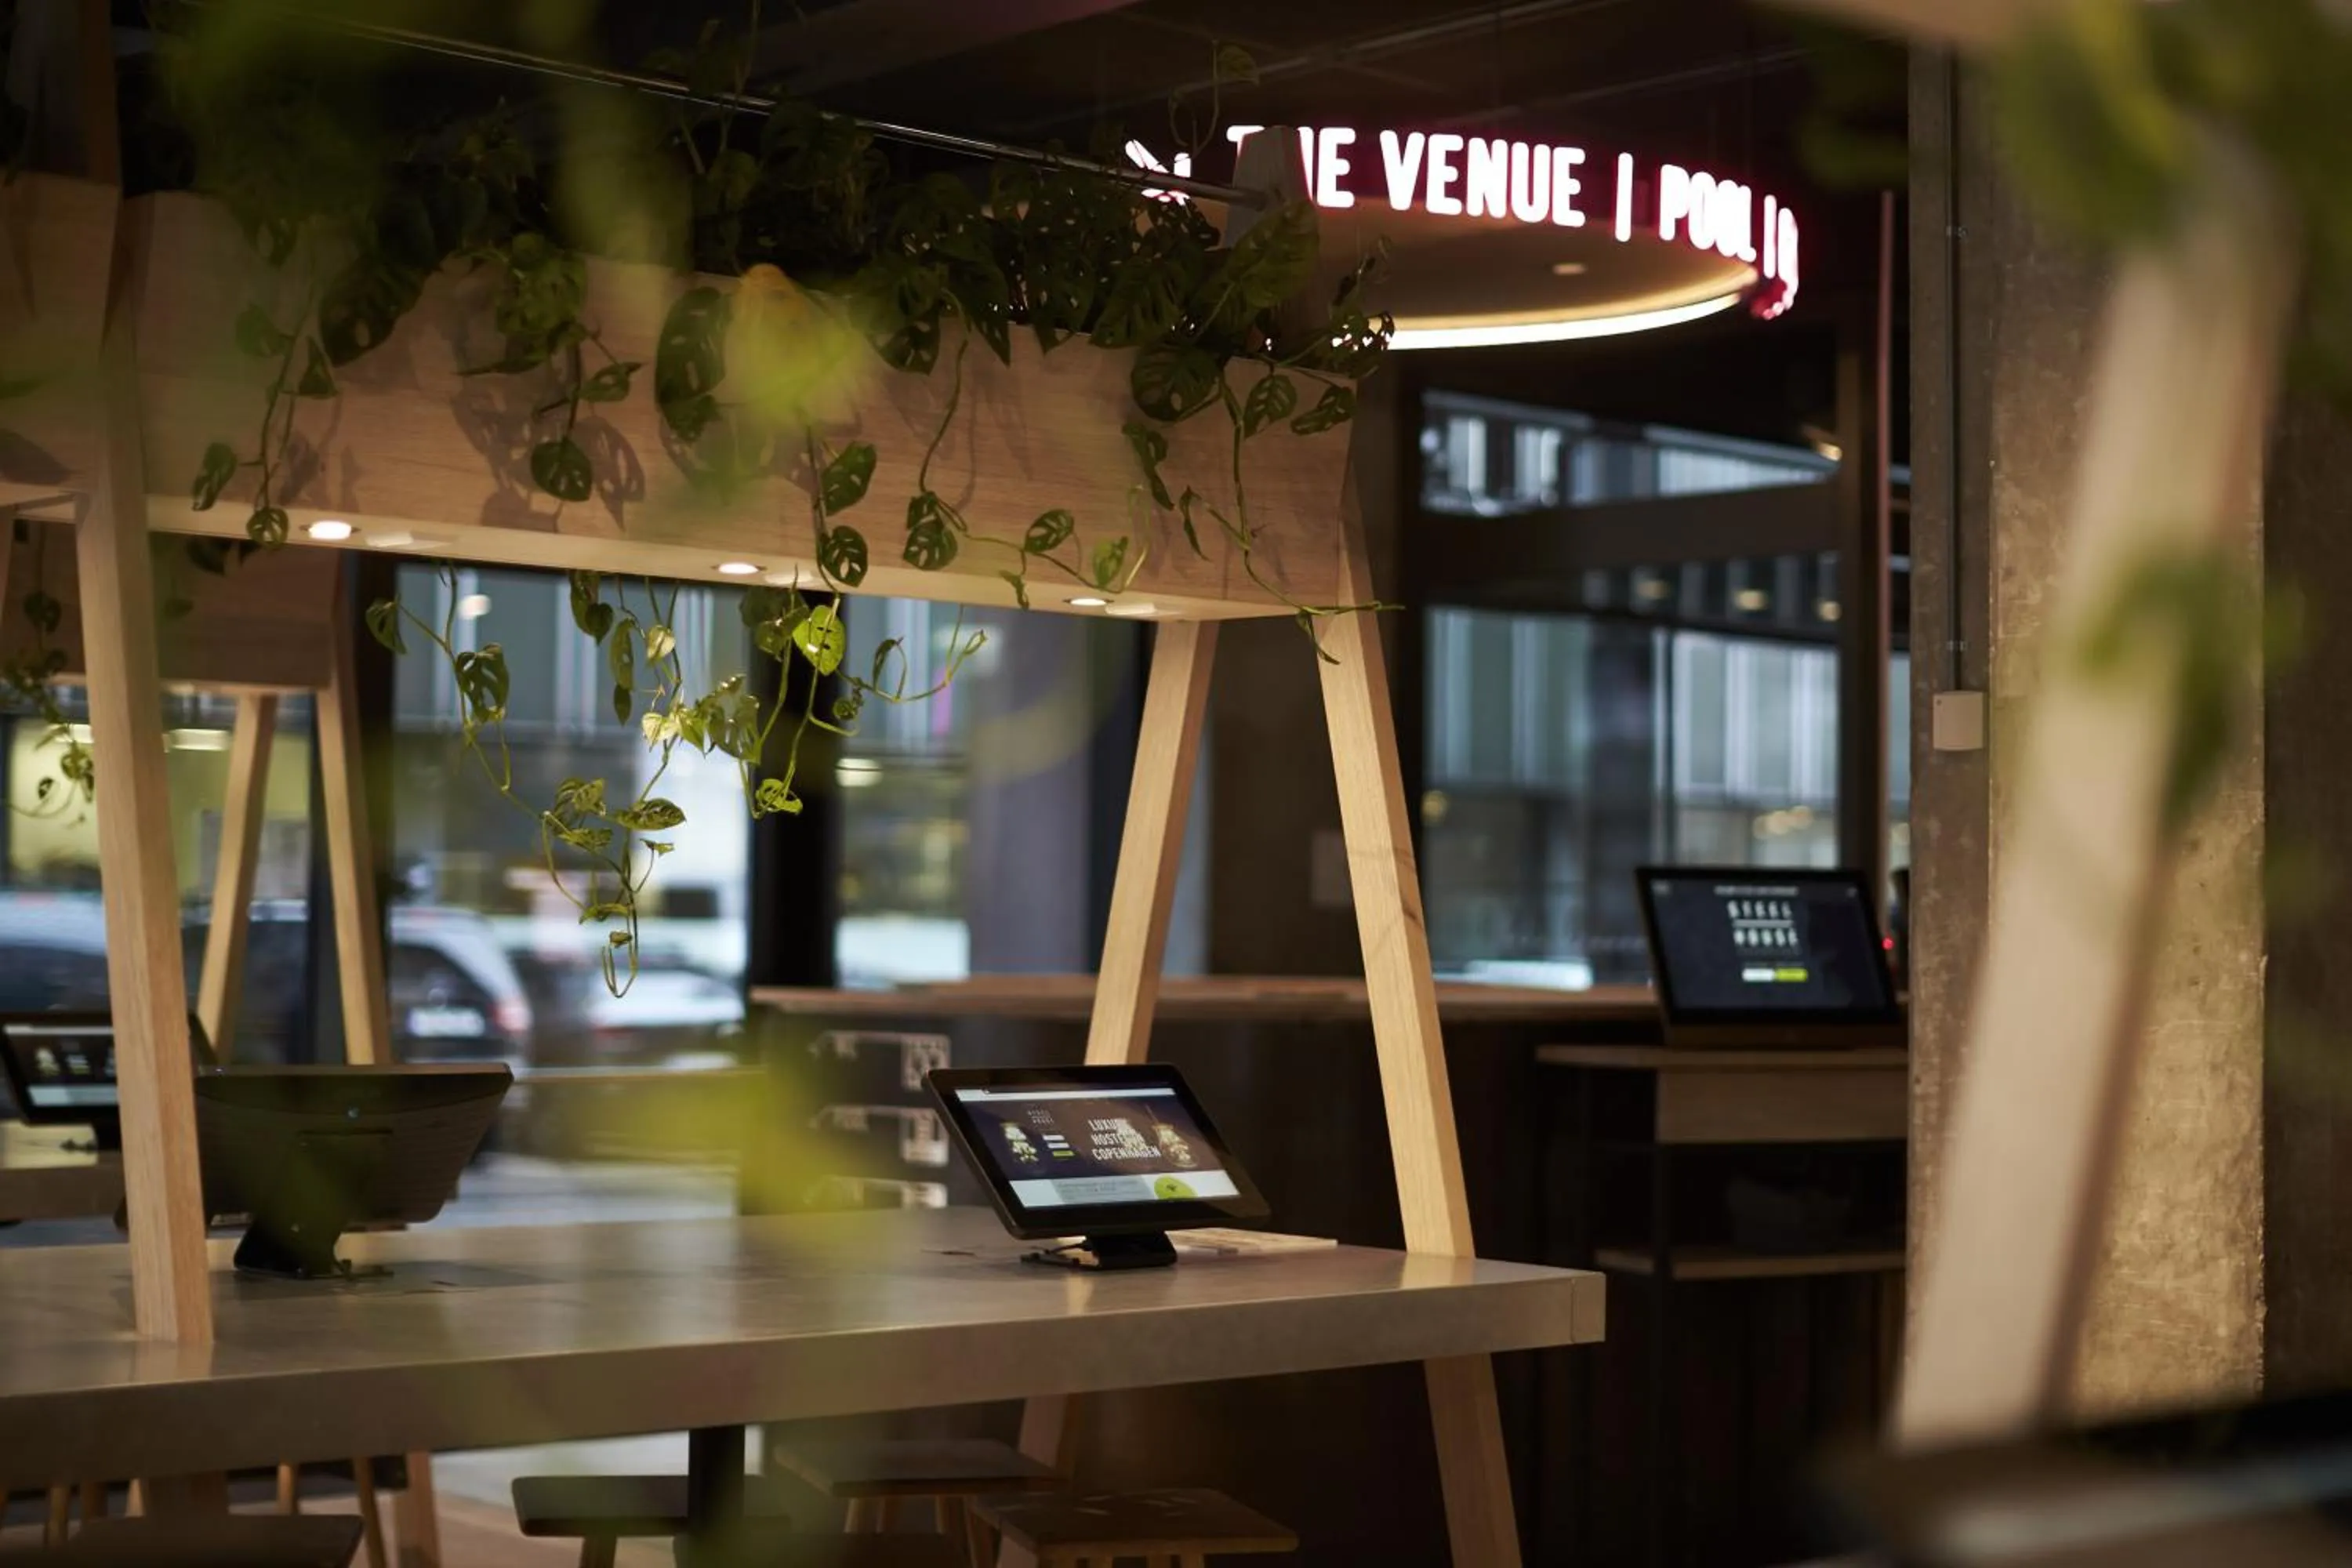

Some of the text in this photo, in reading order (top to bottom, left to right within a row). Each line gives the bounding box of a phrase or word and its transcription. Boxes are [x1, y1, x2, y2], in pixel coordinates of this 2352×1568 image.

[1226, 125, 1356, 208] TE
[1379, 129, 1586, 227] VENUE
[1659, 164, 1756, 262] POOL
[1087, 1119, 1134, 1131] LUXU
